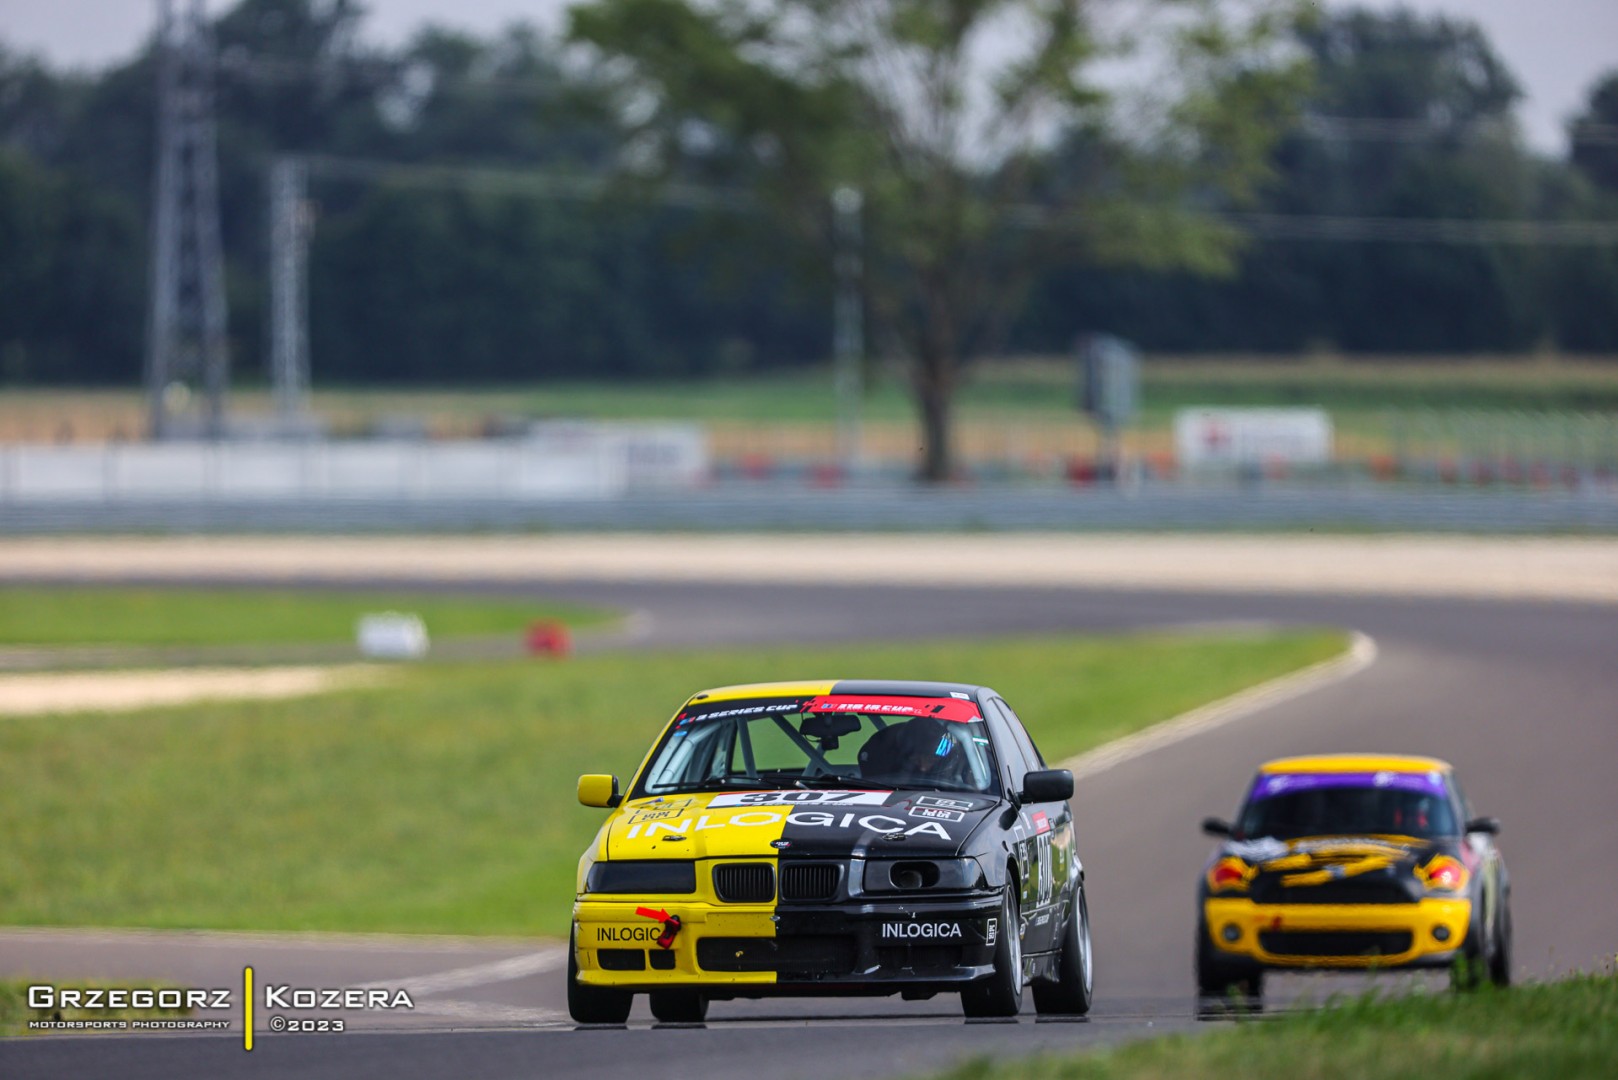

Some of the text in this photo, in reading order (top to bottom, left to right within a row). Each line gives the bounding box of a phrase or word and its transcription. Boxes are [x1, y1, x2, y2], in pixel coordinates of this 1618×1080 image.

[765, 704, 798, 712] CUP
[882, 705, 916, 715] CUP
[740, 792, 866, 803] 307
[626, 811, 952, 841] INLOGICA
[596, 927, 662, 942] INLOGIC
[882, 922, 962, 939] INLOGICA
